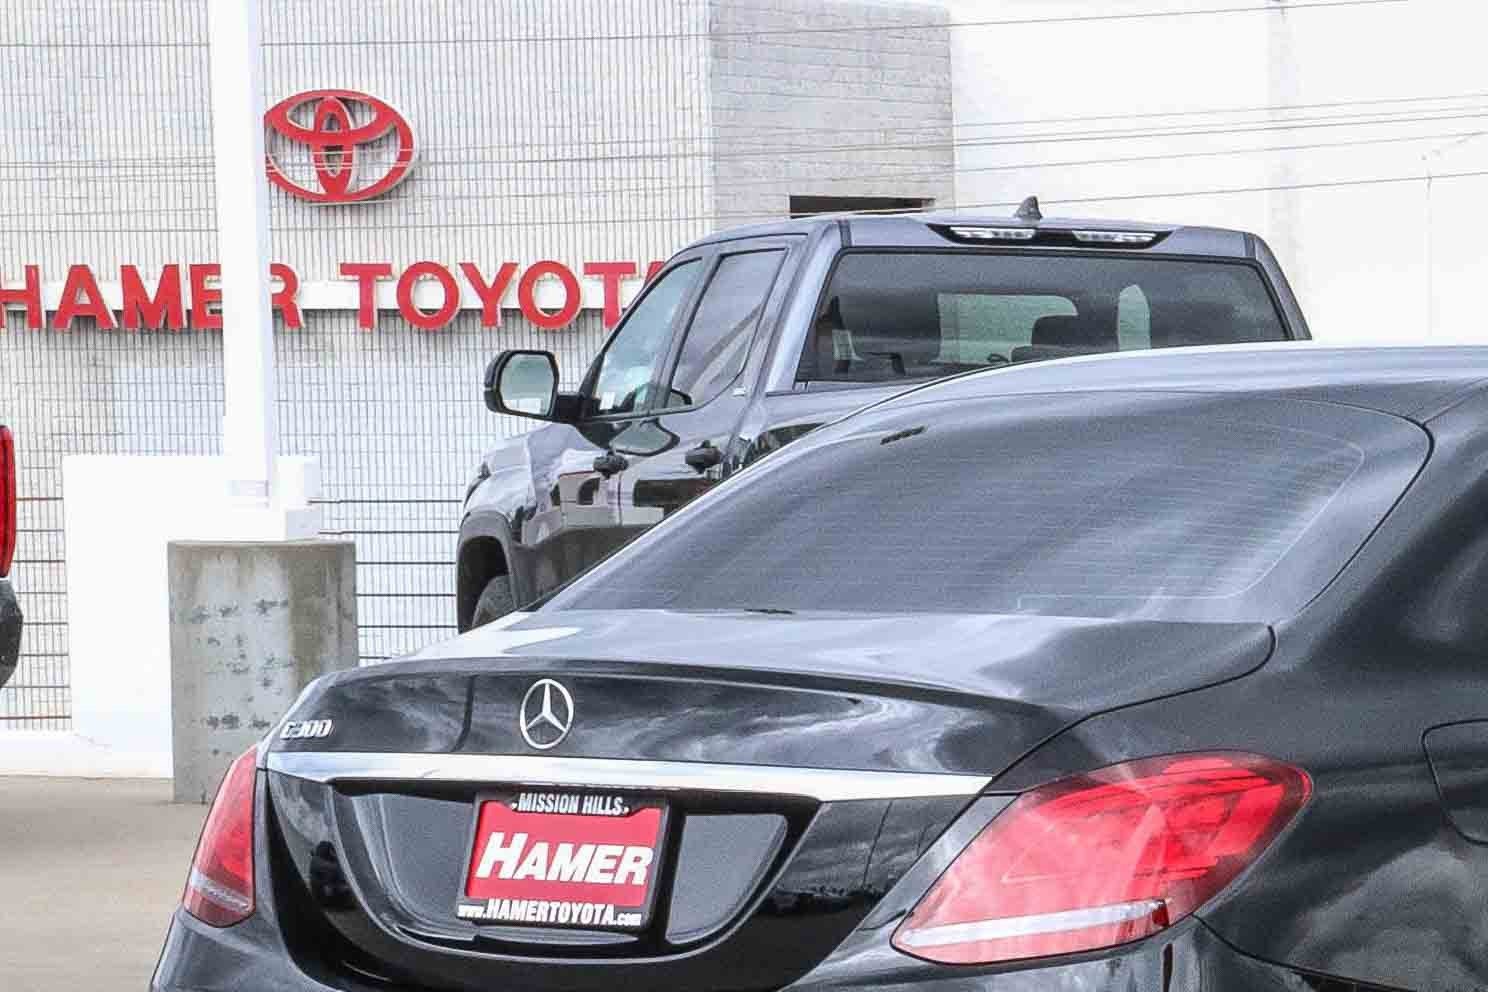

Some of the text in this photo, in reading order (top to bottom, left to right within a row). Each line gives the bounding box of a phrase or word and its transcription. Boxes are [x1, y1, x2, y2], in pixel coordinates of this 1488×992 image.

[0, 261, 664, 330] HAMER TOYOT
[518, 793, 624, 816] MISSION HILLS
[475, 832, 654, 885] HAMER
[457, 898, 643, 926] www.HAMERTOYOTA.com
